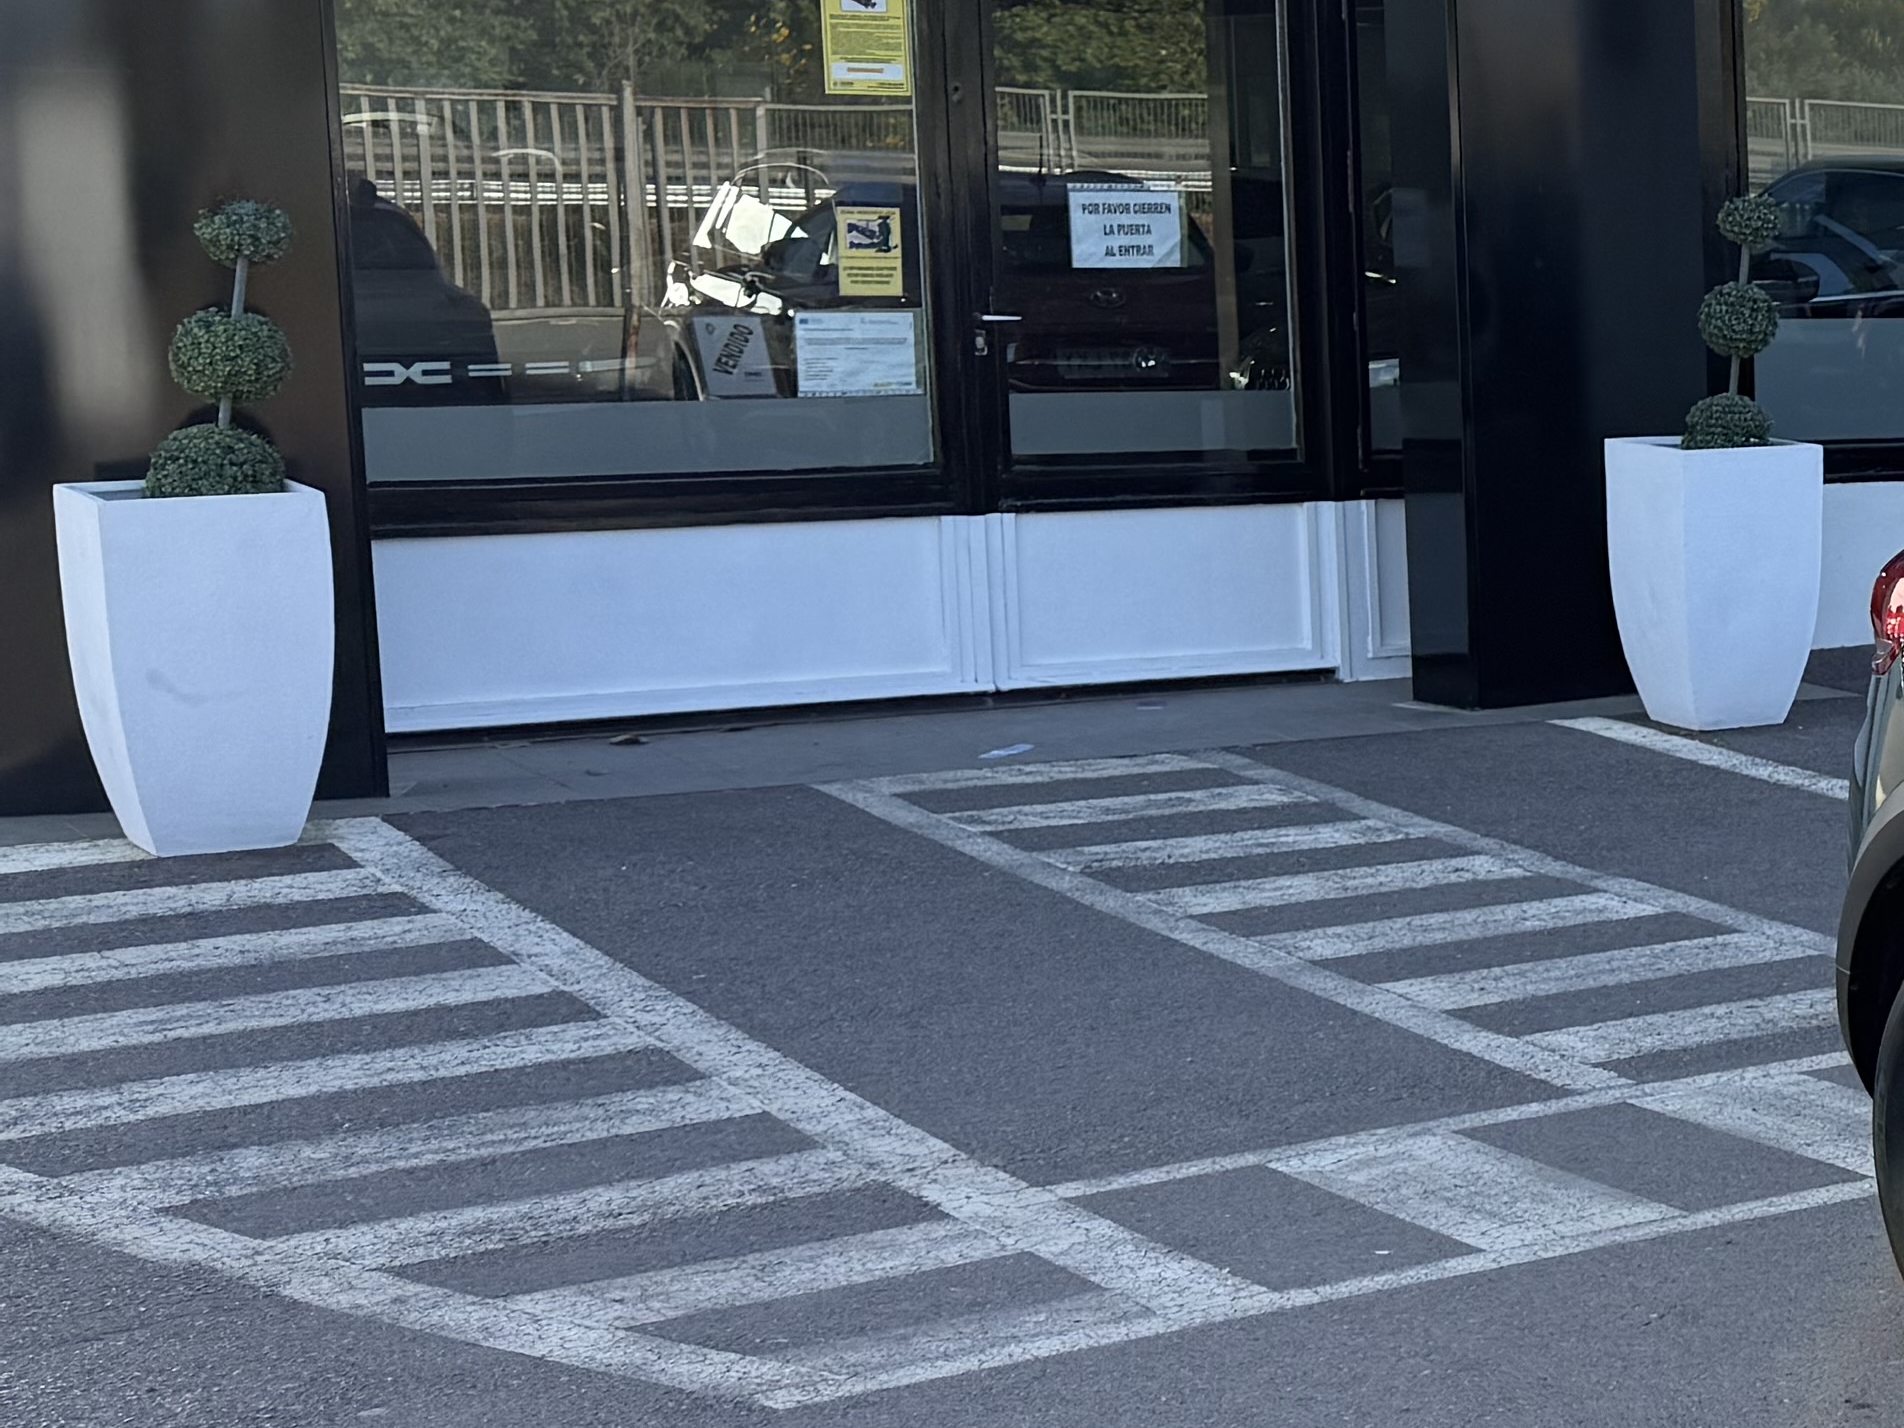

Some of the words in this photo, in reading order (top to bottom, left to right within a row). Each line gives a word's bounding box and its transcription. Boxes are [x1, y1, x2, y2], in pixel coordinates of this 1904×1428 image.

[1081, 203, 1100, 215] POR
[1102, 203, 1132, 215] FAVOR
[1133, 203, 1171, 215] CIERREN
[1103, 224, 1116, 236] LA
[1117, 224, 1152, 236] PUERTA
[1105, 245, 1116, 257] AL
[1118, 245, 1154, 257] ENTRAR
[711, 322, 755, 376] VENDIDO
